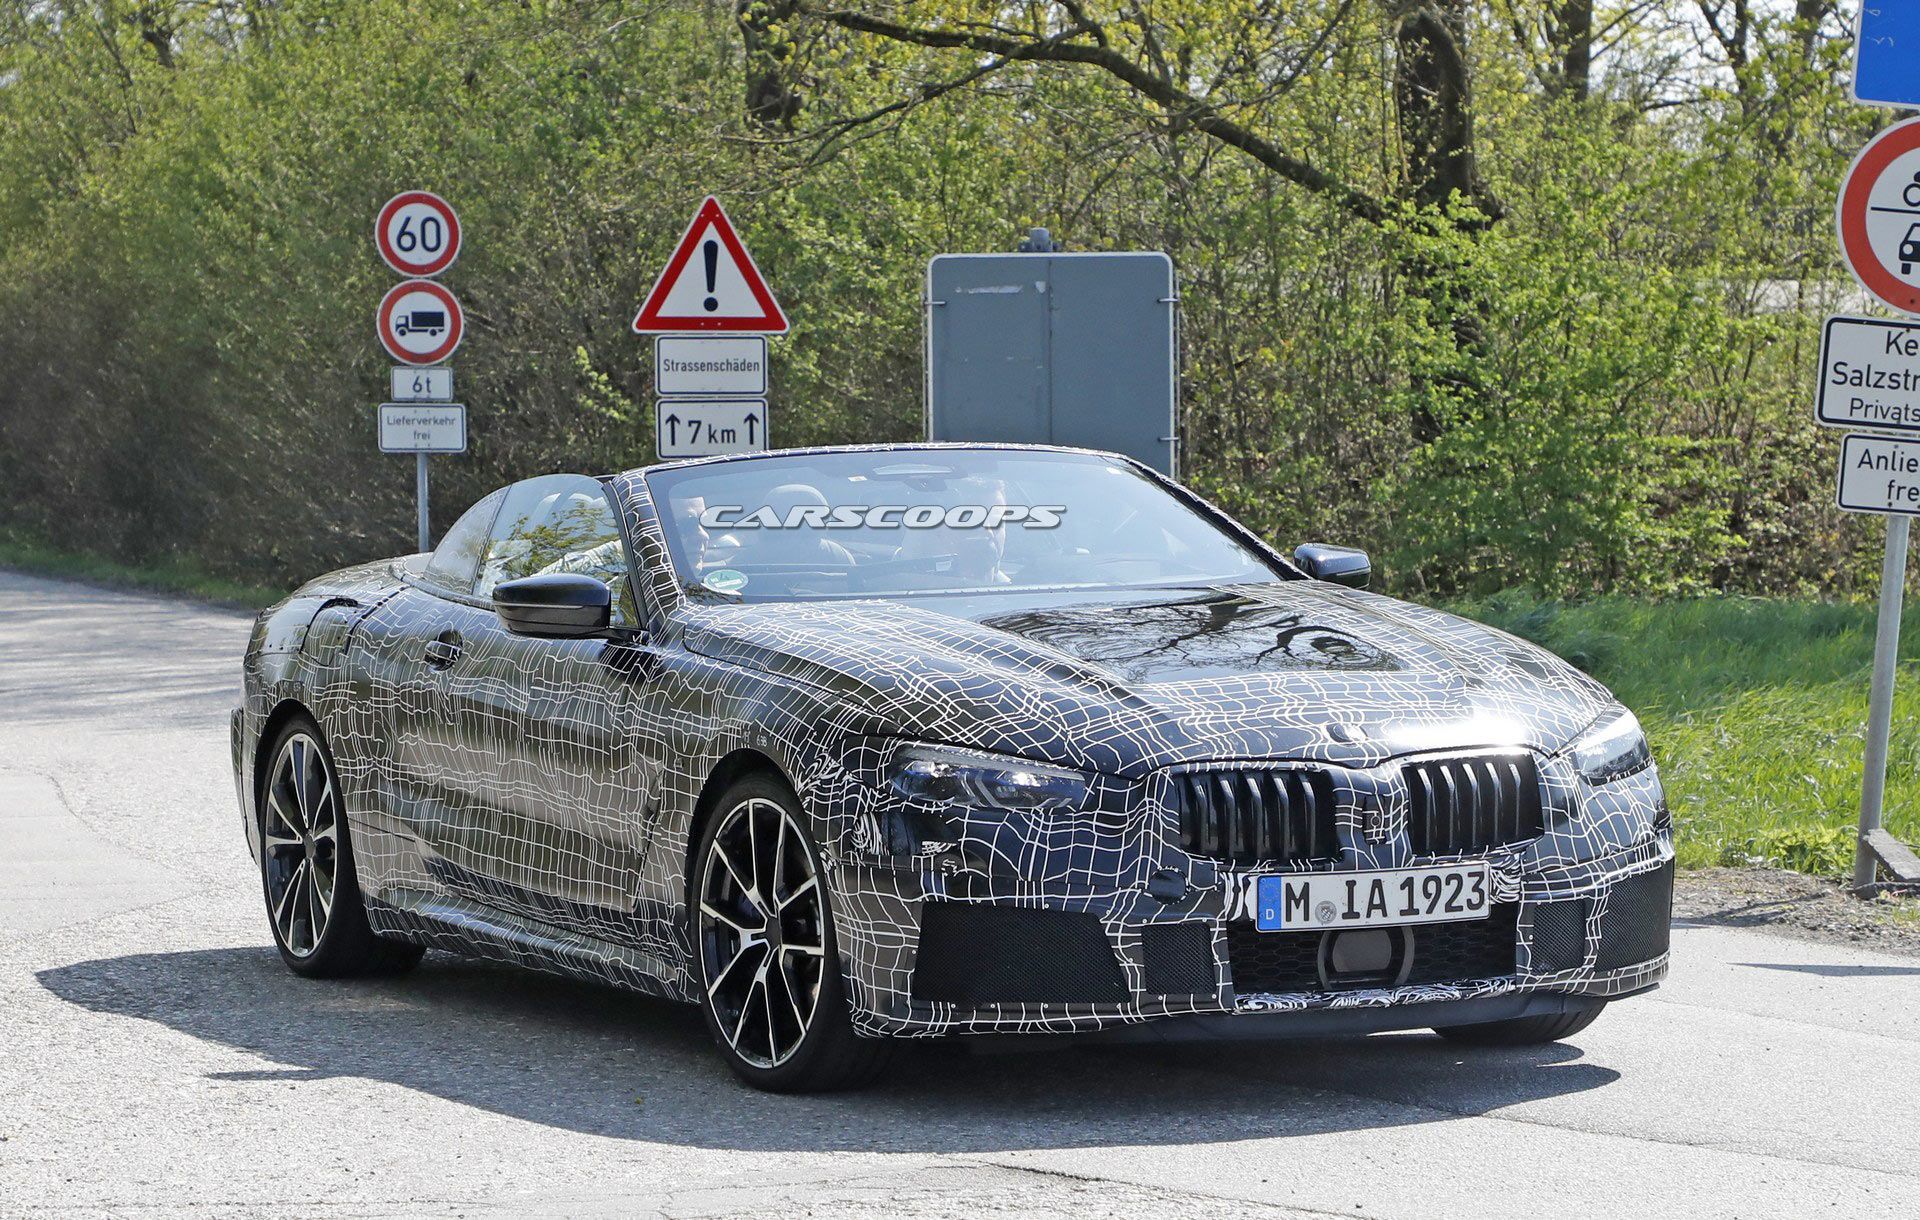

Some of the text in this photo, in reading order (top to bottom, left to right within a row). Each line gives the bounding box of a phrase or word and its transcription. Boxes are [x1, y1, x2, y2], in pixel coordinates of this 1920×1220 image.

[396, 215, 441, 252] 60
[1885, 330, 1919, 357] Ke
[663, 358, 760, 372] Strassenschäden
[1831, 361, 1920, 392] Salzstr
[386, 415, 456, 426] Lieferverkehr
[688, 420, 736, 444] 7 km
[413, 430, 431, 440] frei
[1857, 448, 1919, 473] Anlie
[1887, 479, 1920, 502] fre
[1285, 871, 1486, 923] M IA 1923
[1265, 908, 1275, 920] D
